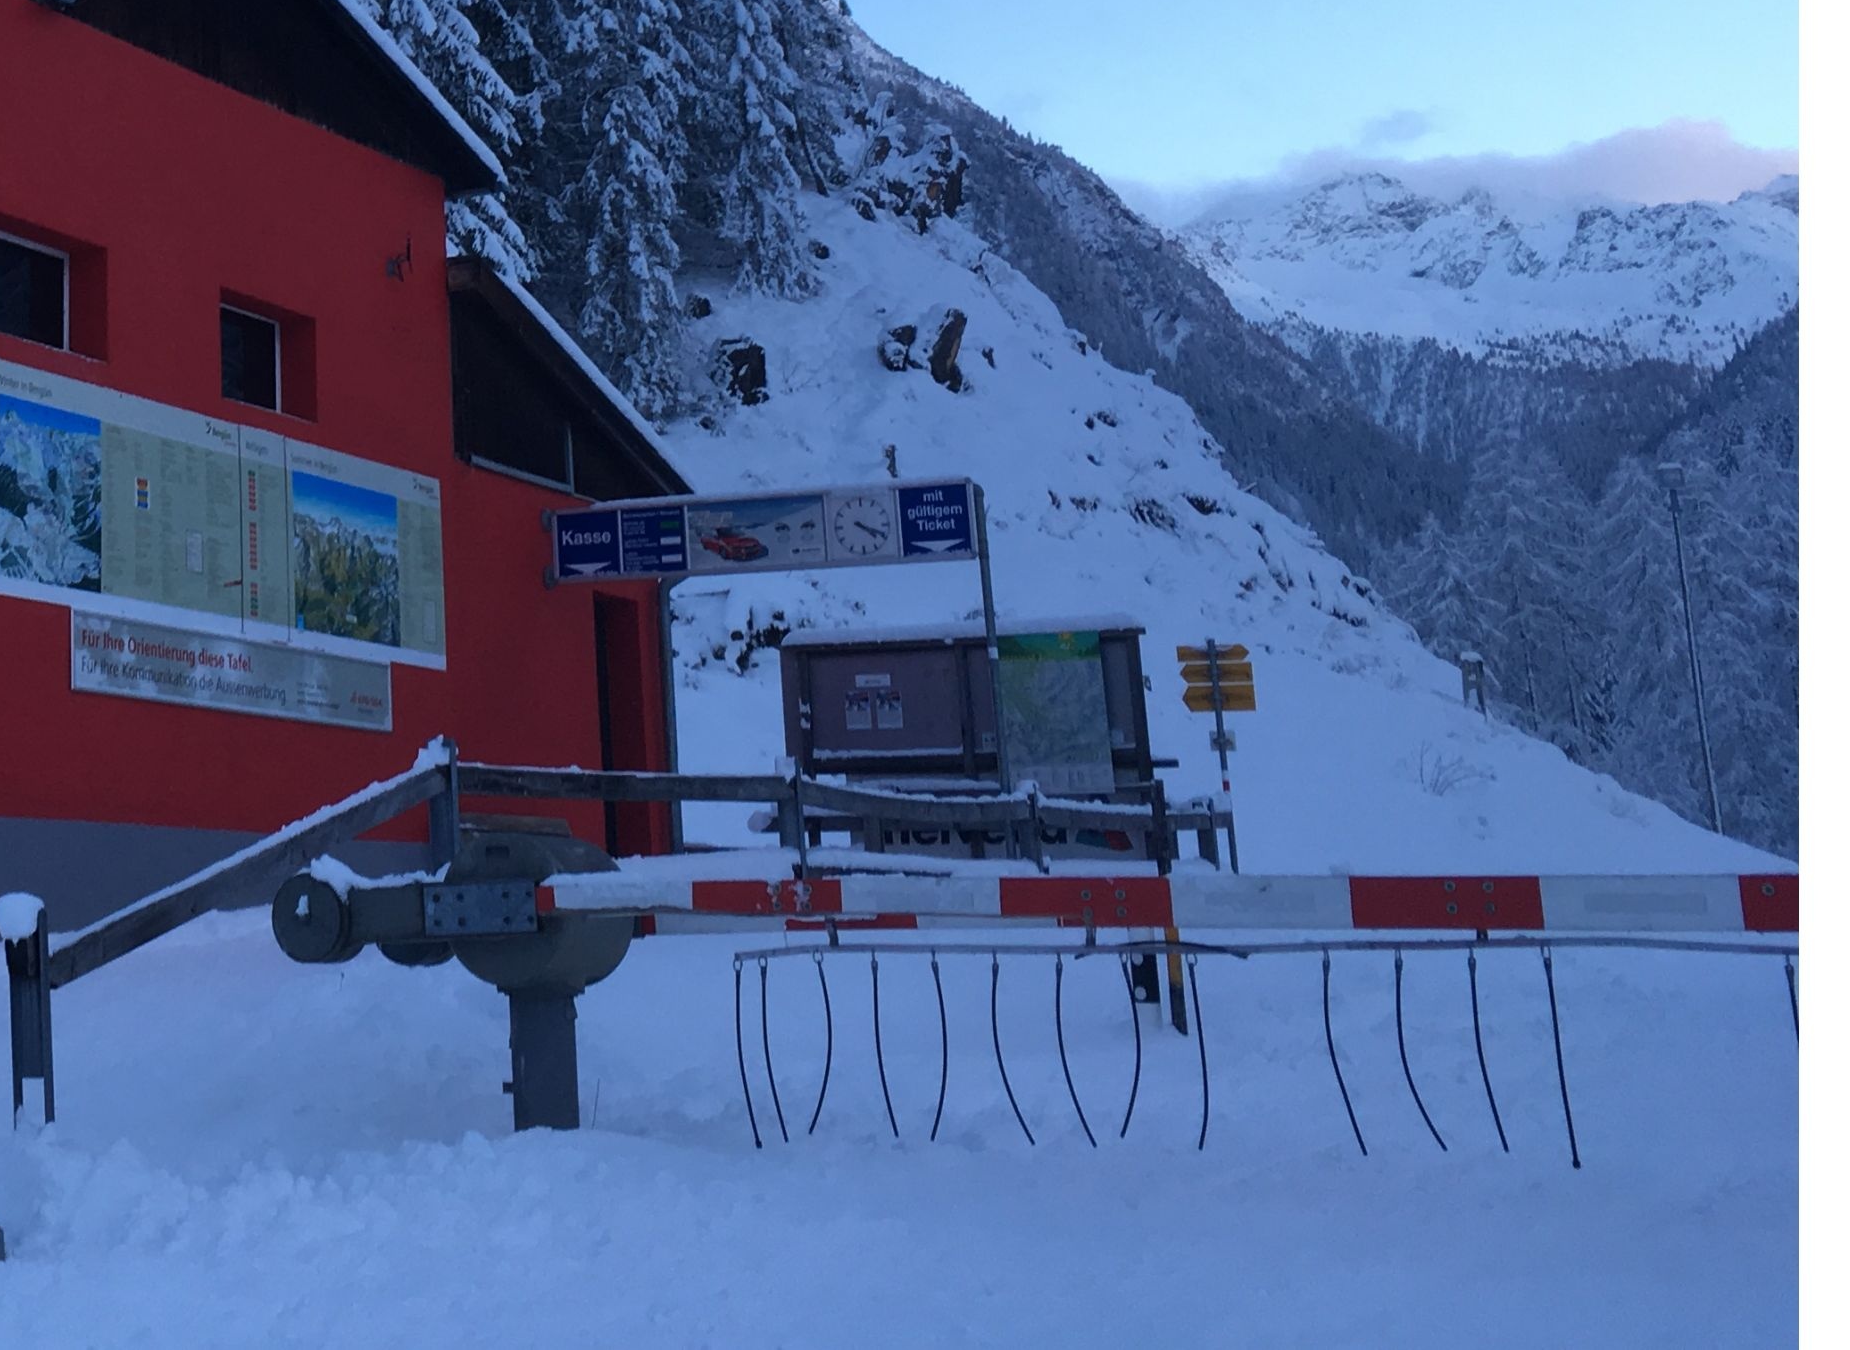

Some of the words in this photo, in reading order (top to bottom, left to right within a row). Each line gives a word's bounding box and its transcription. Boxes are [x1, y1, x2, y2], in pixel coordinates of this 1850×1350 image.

[923, 489, 944, 502] mit
[907, 504, 962, 521] gültigem
[916, 518, 956, 531] Ticket
[562, 530, 611, 546] Kasse
[81, 629, 100, 649] Für
[103, 631, 125, 653] Ihre
[127, 636, 196, 668] Orientierung
[198, 650, 225, 668] diese
[226, 652, 254, 674] Tafel.
[81, 656, 98, 674] Für
[100, 659, 120, 677] Ihre
[121, 663, 197, 689] Kommunikation
[216, 678, 287, 706] Aussenwerbung
